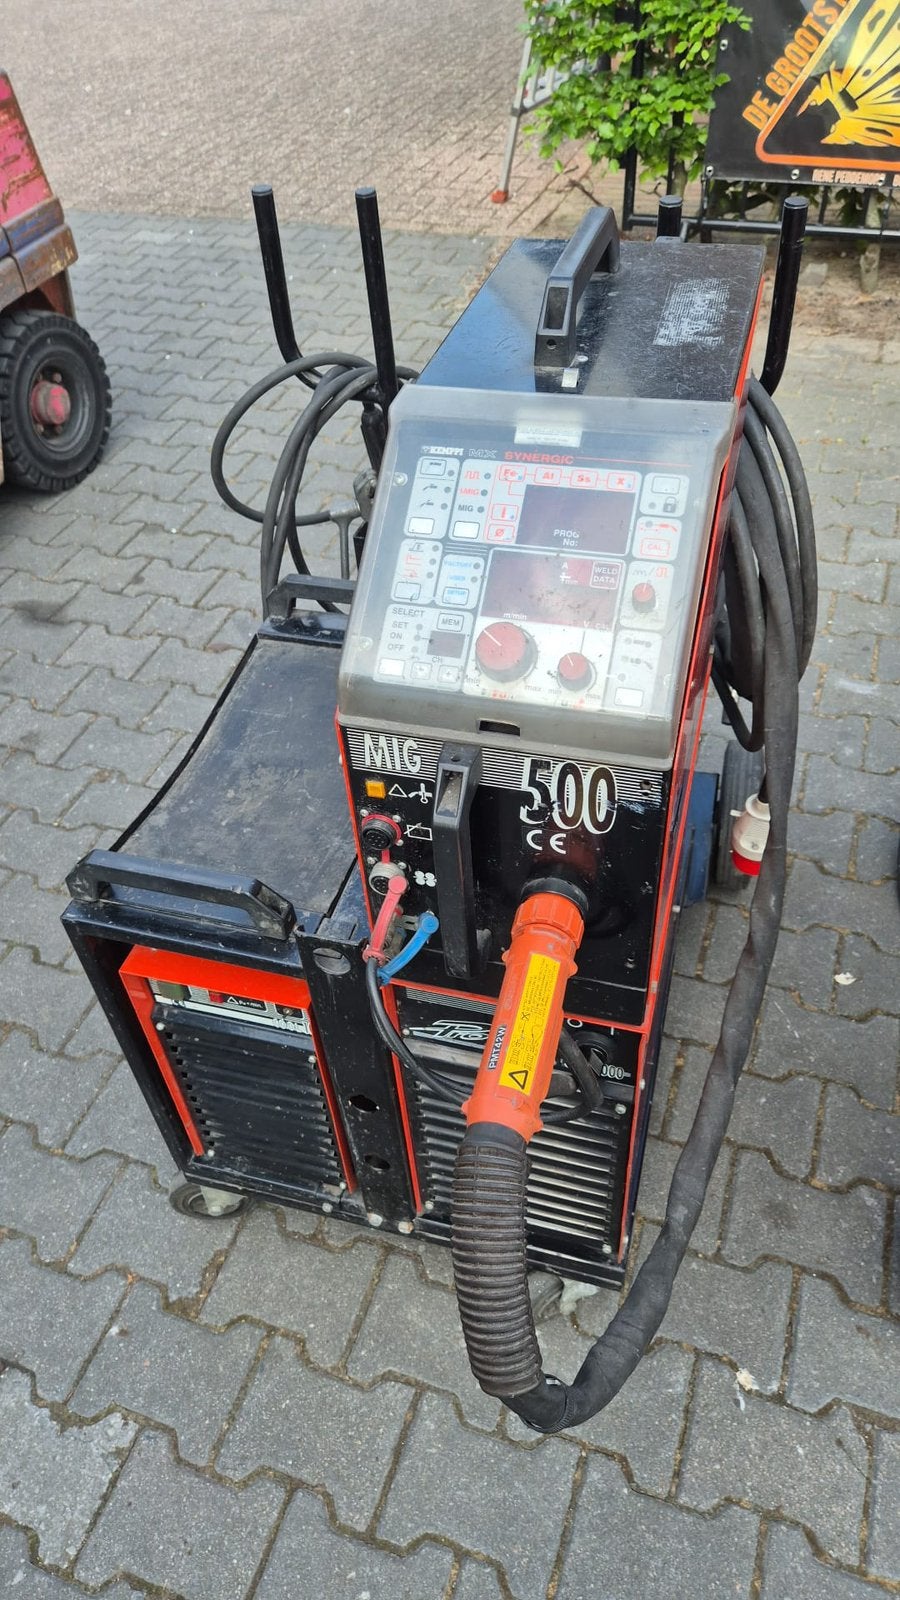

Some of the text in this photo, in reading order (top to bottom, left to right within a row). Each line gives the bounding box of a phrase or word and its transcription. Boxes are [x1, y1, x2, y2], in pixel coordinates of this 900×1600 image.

[742, 0, 847, 131] DE GROOTS
[468, 448, 498, 459] MX
[504, 451, 575, 465] SYNERGIC
[458, 504, 474, 512] MIG
[594, 566, 618, 575] WELD
[593, 575, 615, 584] DATA
[392, 607, 425, 618] SELECT
[503, 612, 527, 621] m/min
[392, 621, 409, 630] SET
[441, 618, 460, 627] MEM
[389, 631, 403, 640] ON
[387, 643, 406, 652] OFF
[363, 733, 422, 774] MIG
[519, 758, 617, 834] 500
[488, 1026, 506, 1069] PMT42W
